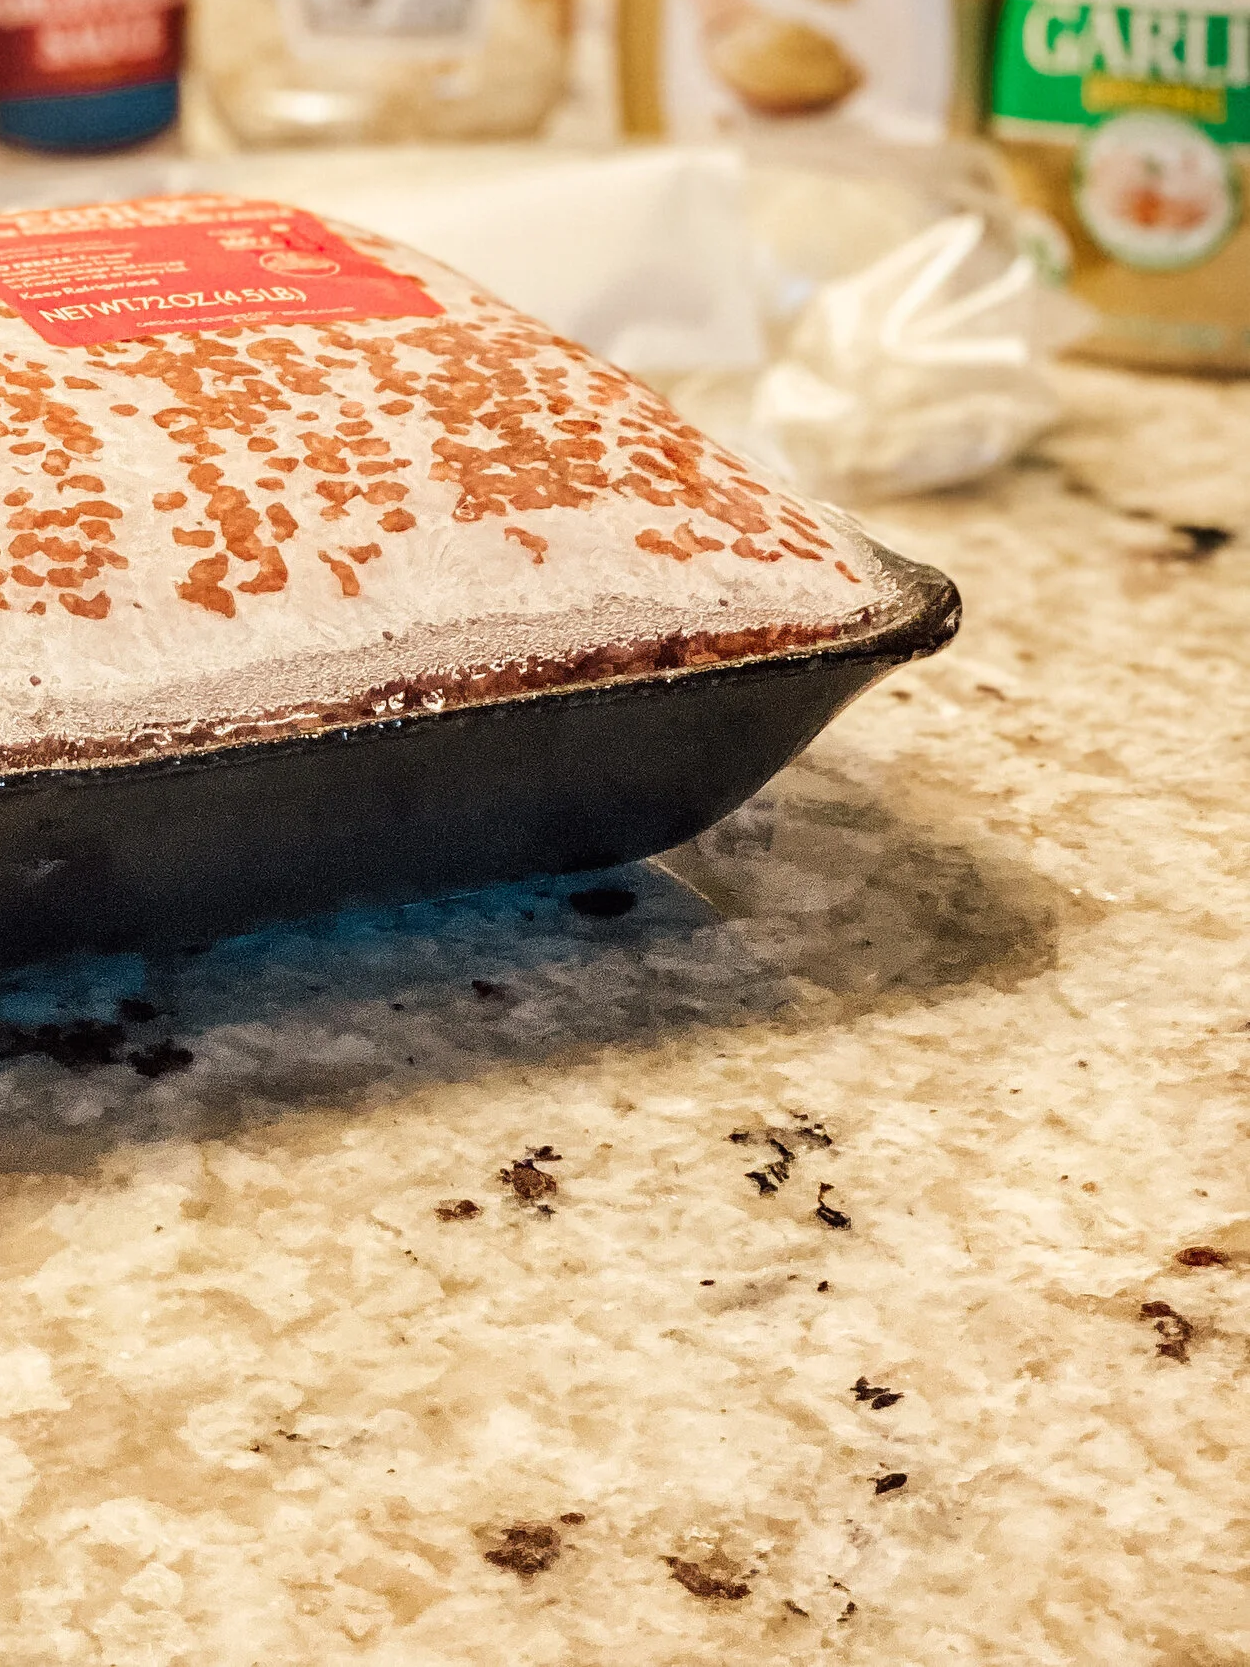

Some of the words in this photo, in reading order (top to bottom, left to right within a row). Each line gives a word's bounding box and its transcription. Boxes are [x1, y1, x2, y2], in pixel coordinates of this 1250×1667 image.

[1022, 1, 1250, 89] GARLI
[19, 288, 63, 301] Keep
[63, 278, 160, 295] Refrigerated
[38, 303, 94, 323] NET
[137, 295, 172, 311] 72
